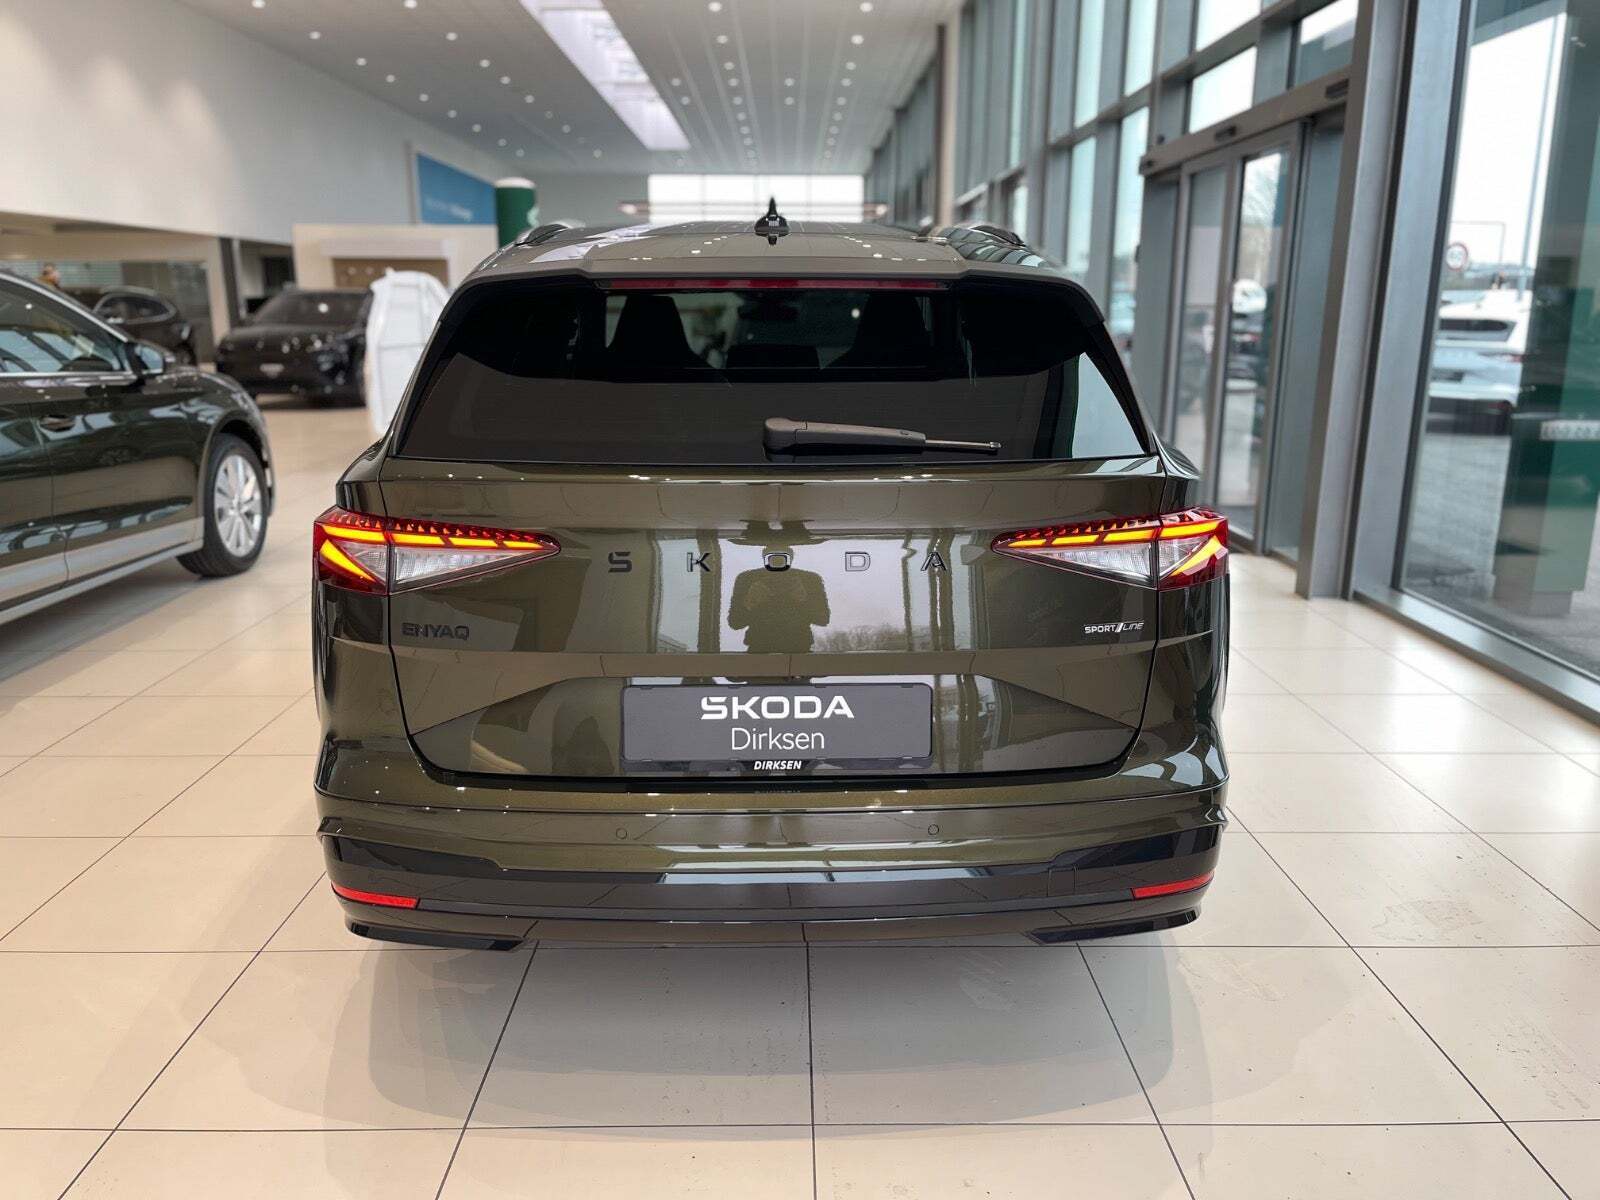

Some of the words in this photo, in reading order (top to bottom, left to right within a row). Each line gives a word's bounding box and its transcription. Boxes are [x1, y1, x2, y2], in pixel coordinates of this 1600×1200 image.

[402, 622, 469, 640] ENYAQ
[731, 727, 825, 750] Dirksen
[753, 760, 802, 770] DIRKSEN
